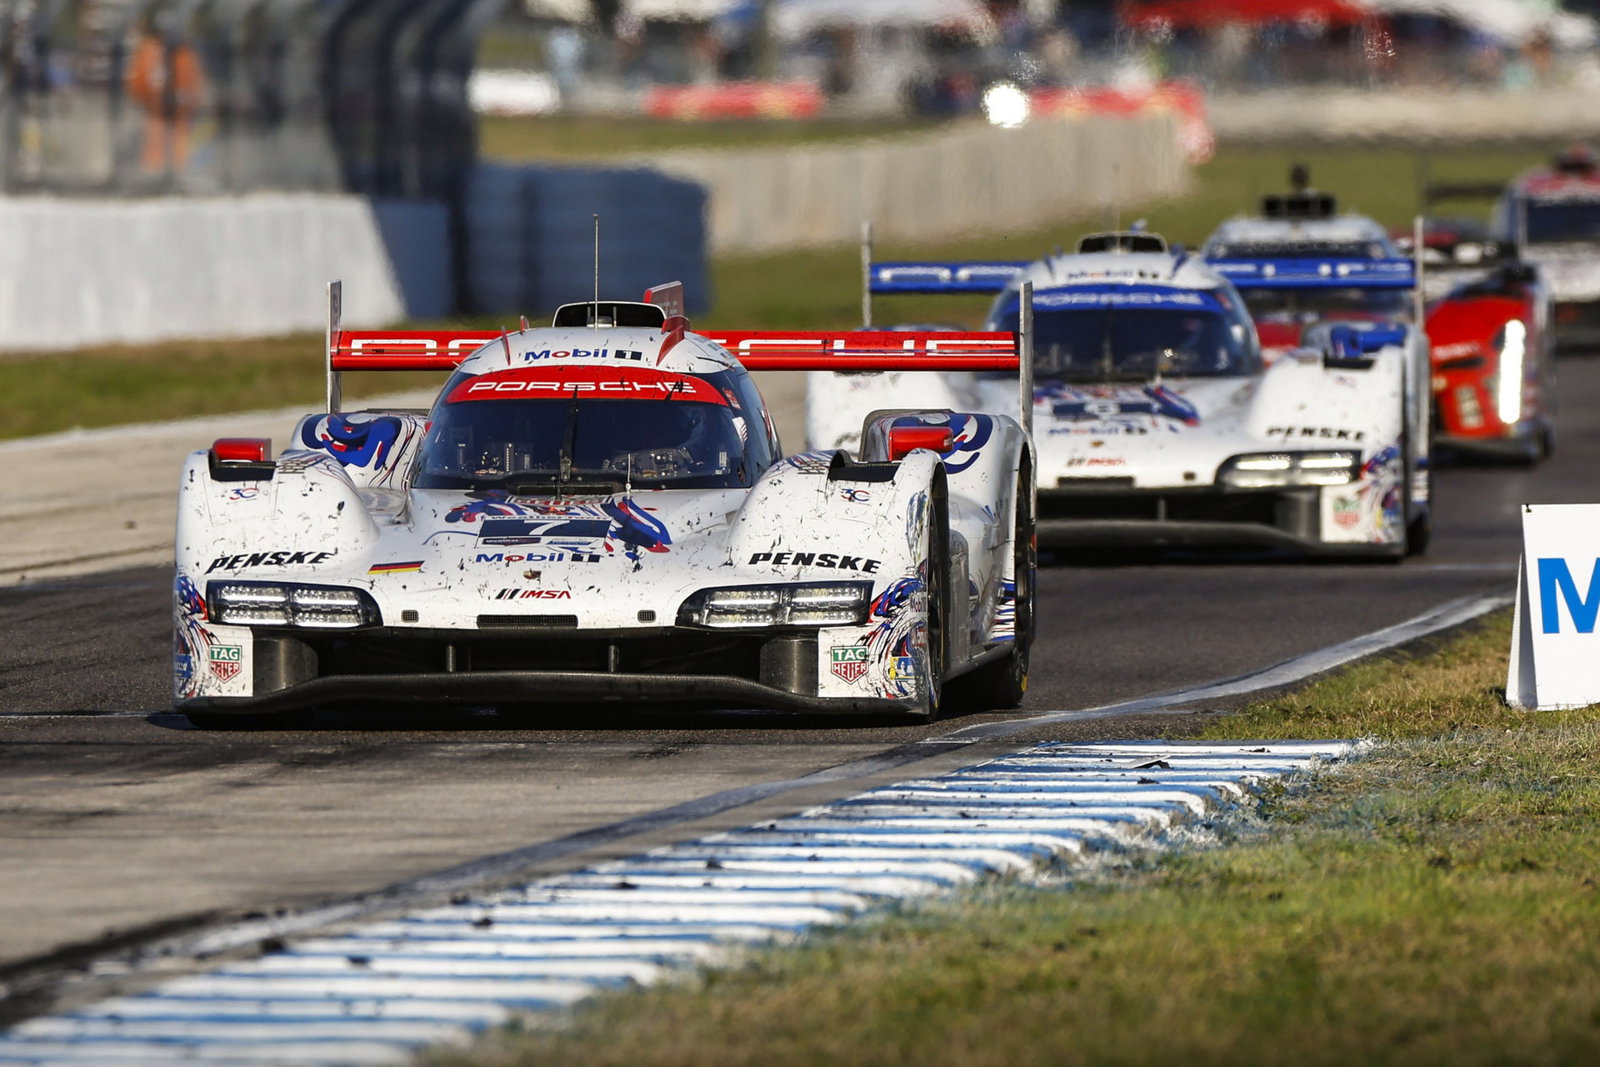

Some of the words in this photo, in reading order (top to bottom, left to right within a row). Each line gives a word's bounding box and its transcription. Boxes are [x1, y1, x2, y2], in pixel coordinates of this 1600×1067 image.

[524, 349, 608, 361] Mobil
[467, 382, 697, 394] PORSCHE
[523, 520, 571, 536] 7
[205, 552, 334, 575] PENSKE
[476, 553, 564, 563] Mobil
[748, 553, 882, 574] PENSKE
[520, 590, 571, 599] IMSA
[1537, 558, 1600, 634] M
[211, 648, 239, 660] TAG
[834, 649, 867, 660] TAG
[211, 663, 240, 679] HEUER
[834, 663, 867, 681] HEUER
